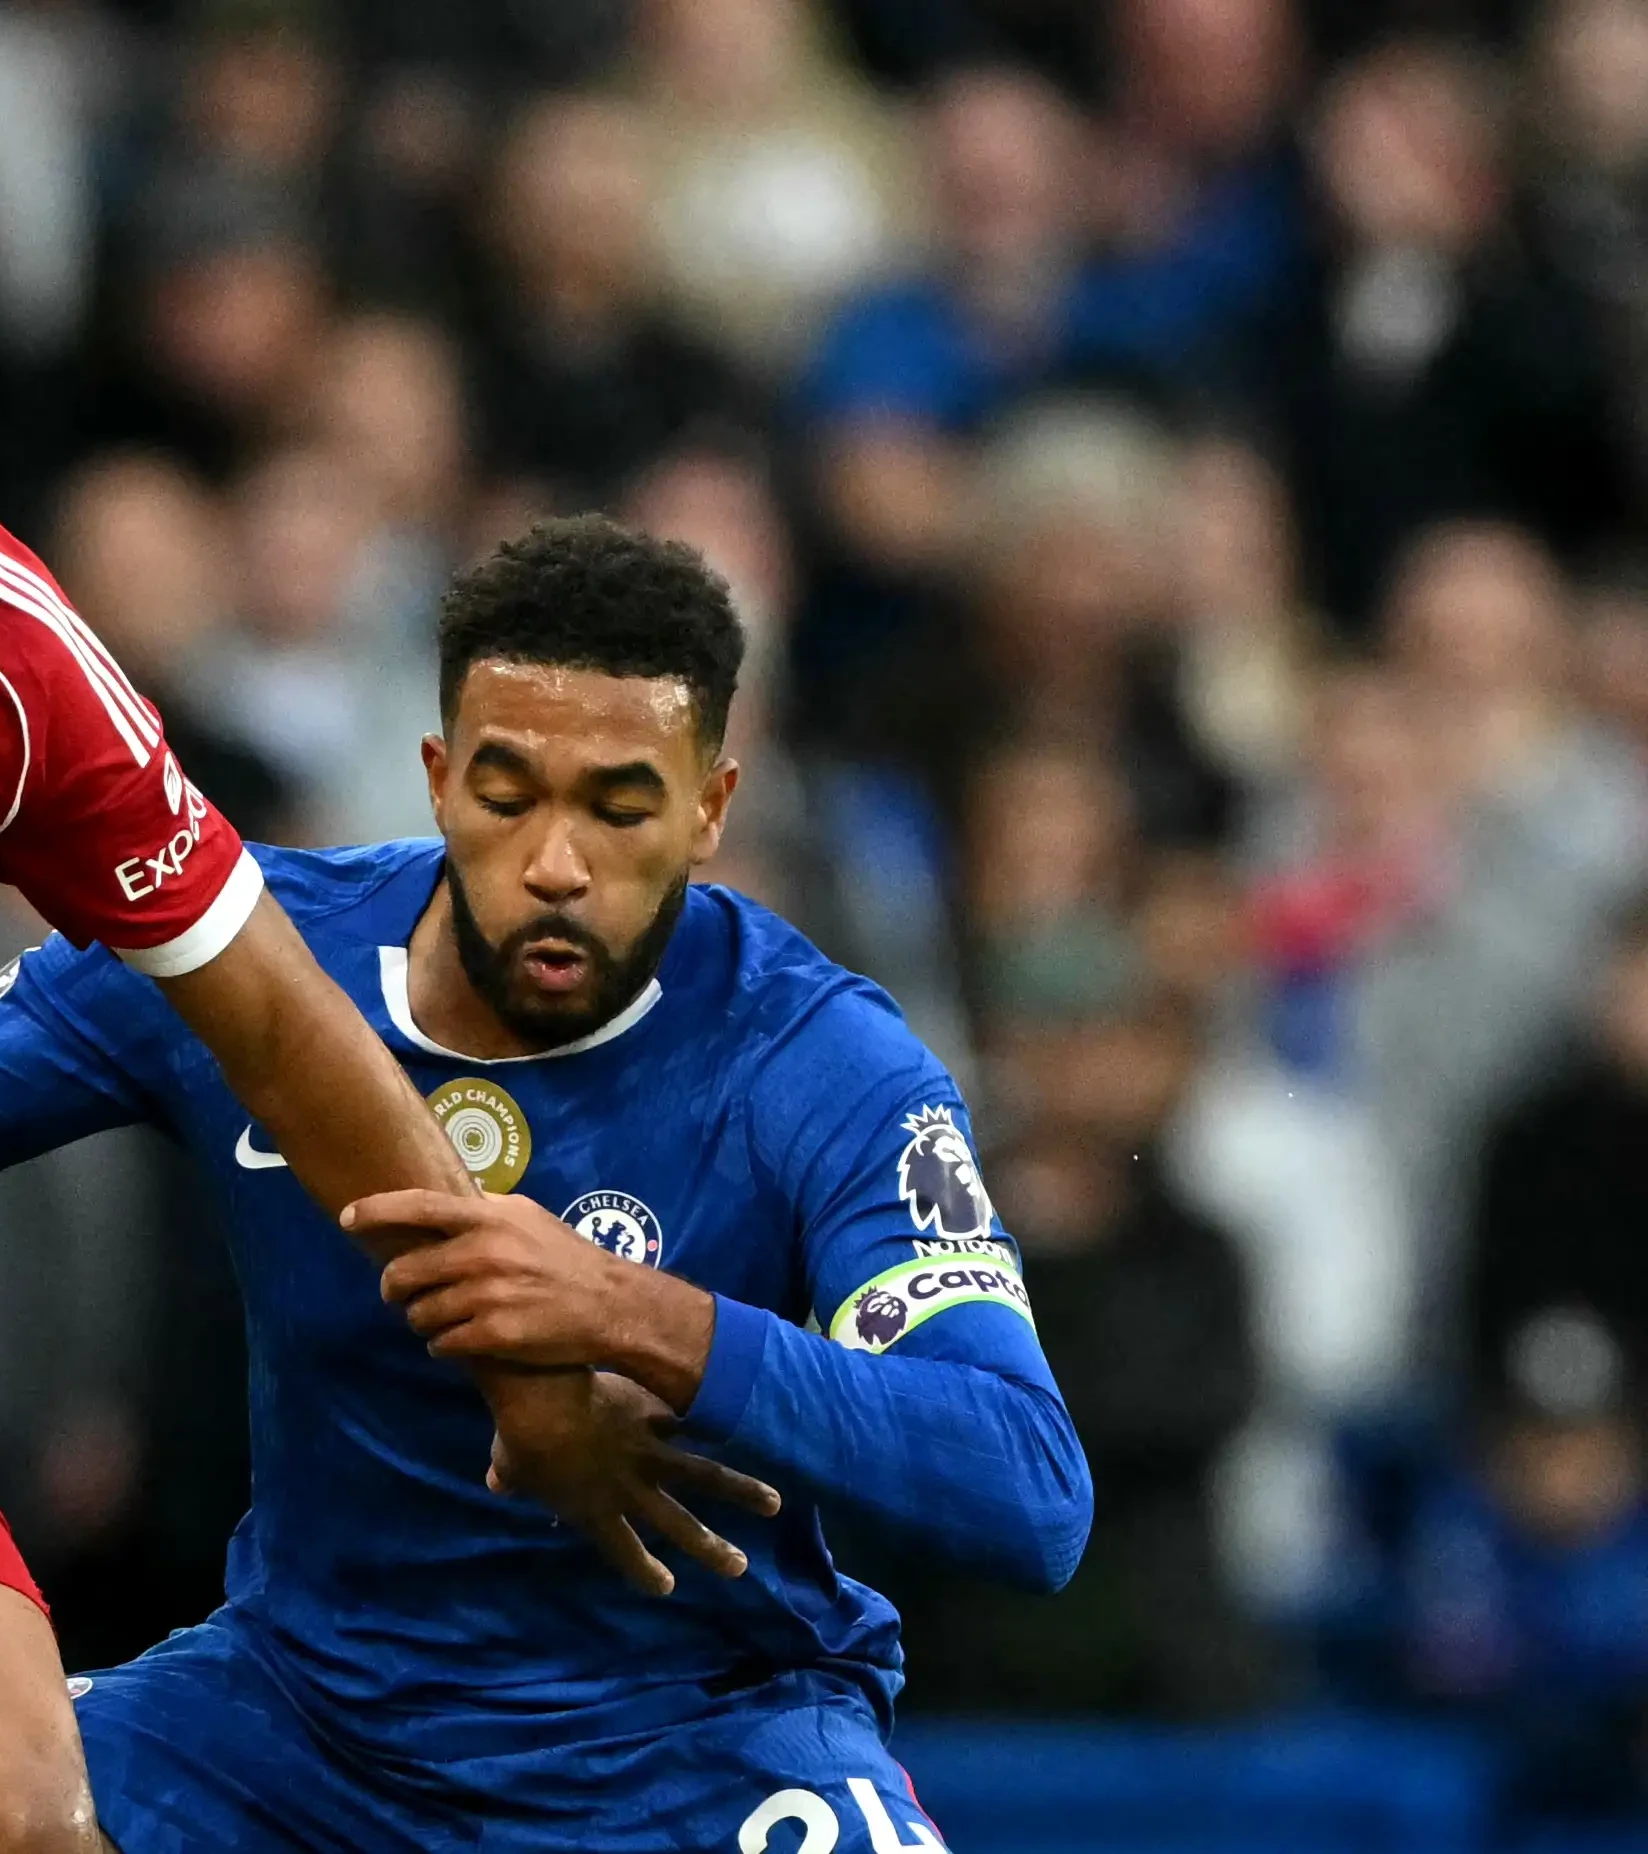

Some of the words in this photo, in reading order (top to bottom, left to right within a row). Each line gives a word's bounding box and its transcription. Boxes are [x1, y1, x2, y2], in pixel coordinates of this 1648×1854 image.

[433, 1091, 463, 1120] RLD
[465, 1088, 521, 1168] CHAMPIONS
[578, 1195, 649, 1227] CHELSEA
